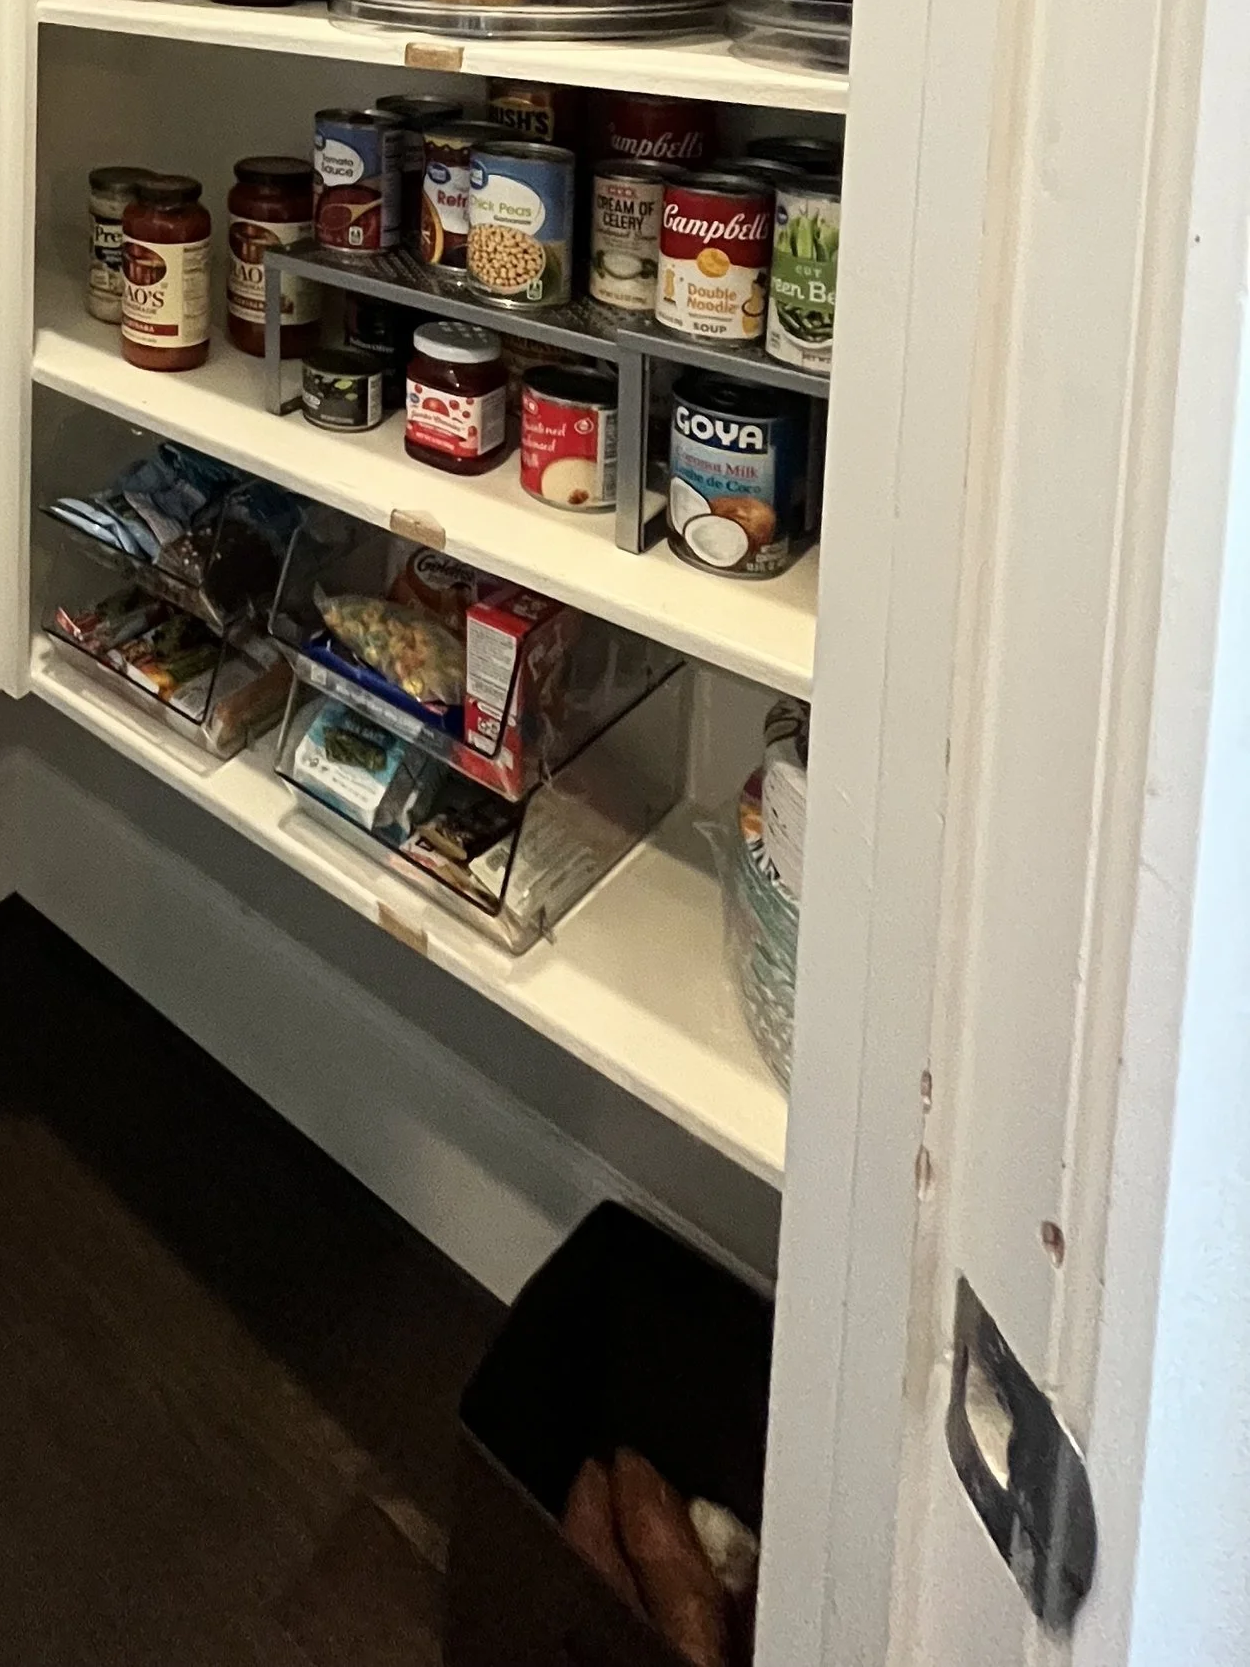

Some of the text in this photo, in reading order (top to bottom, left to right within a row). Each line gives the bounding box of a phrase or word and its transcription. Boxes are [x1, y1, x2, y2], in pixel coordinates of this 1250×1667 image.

[498, 201, 532, 218] Peas
[638, 200, 656, 217] OF
[602, 212, 645, 232] CELERY
[686, 282, 738, 302] Double
[686, 297, 739, 315] Noodle
[692, 322, 727, 334] SOUP
[676, 406, 764, 450] GOYA
[726, 462, 760, 478] Milk
[726, 480, 762, 494] Coco
